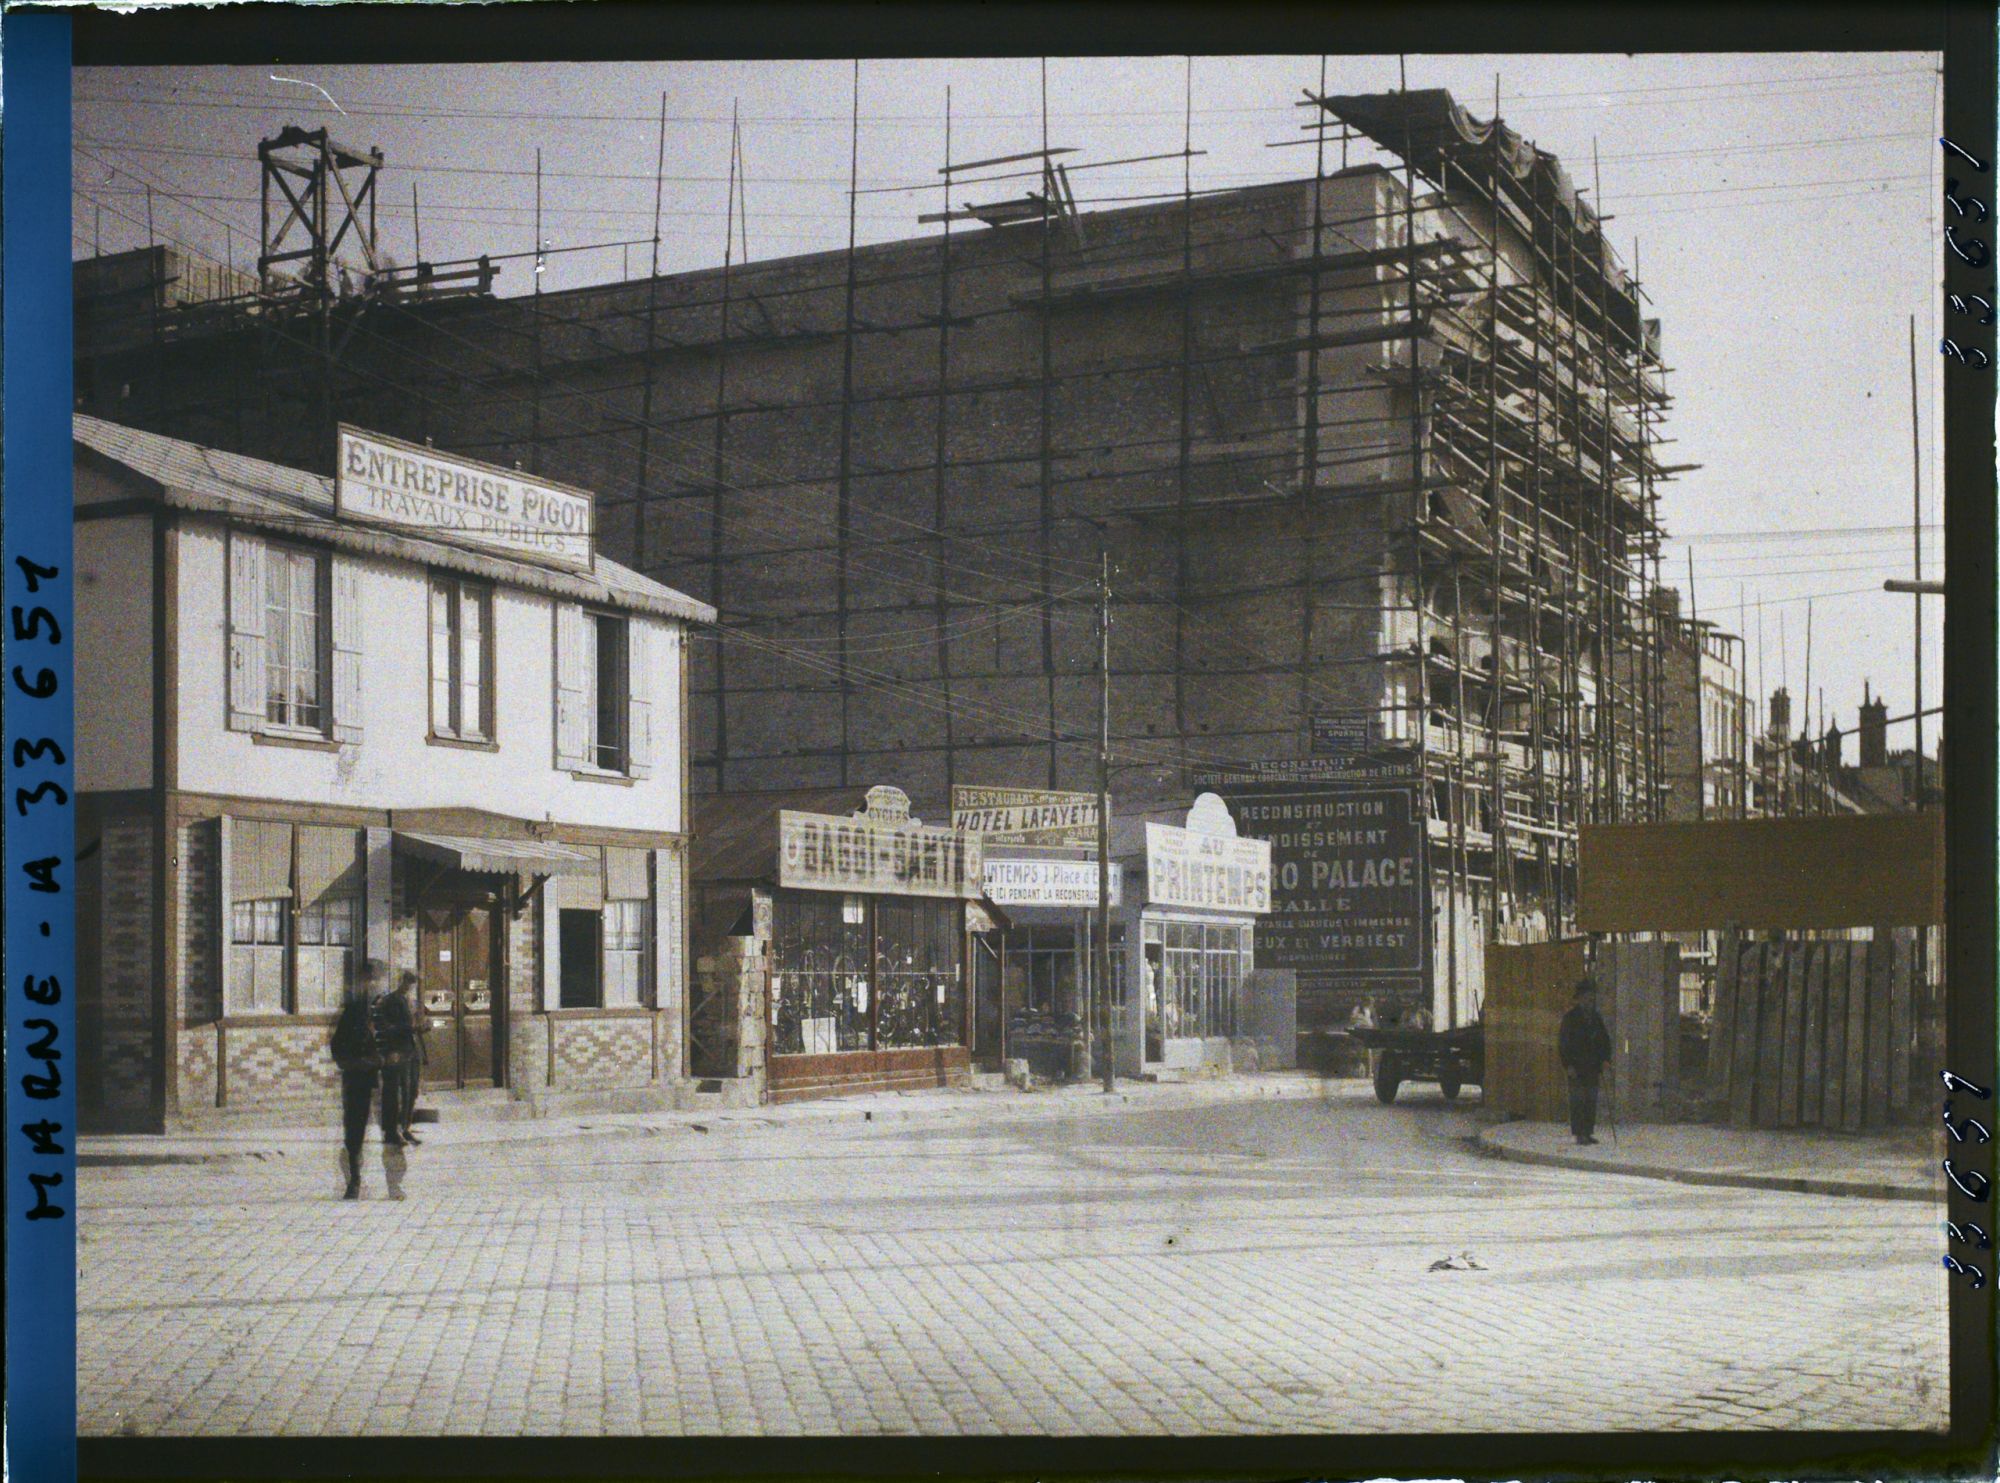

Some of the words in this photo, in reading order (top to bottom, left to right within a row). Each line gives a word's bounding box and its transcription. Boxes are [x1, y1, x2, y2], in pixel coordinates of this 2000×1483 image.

[346, 439, 509, 513] ENTREPRISE
[522, 488, 587, 532] PIGOT
[367, 487, 468, 529] TRAVAUX
[482, 516, 566, 552] PUBLICS
[1250, 757, 1355, 771] RECONSTRUIT
[1381, 763, 1412, 776] REIMS
[958, 789, 1034, 807] RESTAURANT
[868, 807, 909, 821] CYCLES
[956, 810, 1012, 831] HOTEL
[1021, 804, 1100, 829] LAFAYETT
[1240, 801, 1384, 820] RECONSTRUCTION
[1067, 827, 1098, 839] GARA
[1244, 829, 1388, 848] NDISSEMENT
[1199, 837, 1224, 856] AU
[985, 864, 1038, 885] INTEMPS
[1053, 865, 1080, 885] Place
[1312, 856, 1414, 889] PALACE
[1153, 857, 1266, 909] PRINTEMPS
[996, 887, 1006, 900] ICI
[1009, 888, 1041, 900] PENDANT
[1043, 888, 1052, 900] LA
[1271, 898, 1352, 913] SALLE
[1354, 917, 1411, 927] IMMENSE
[21, 974, 65, 1221] MARNE
